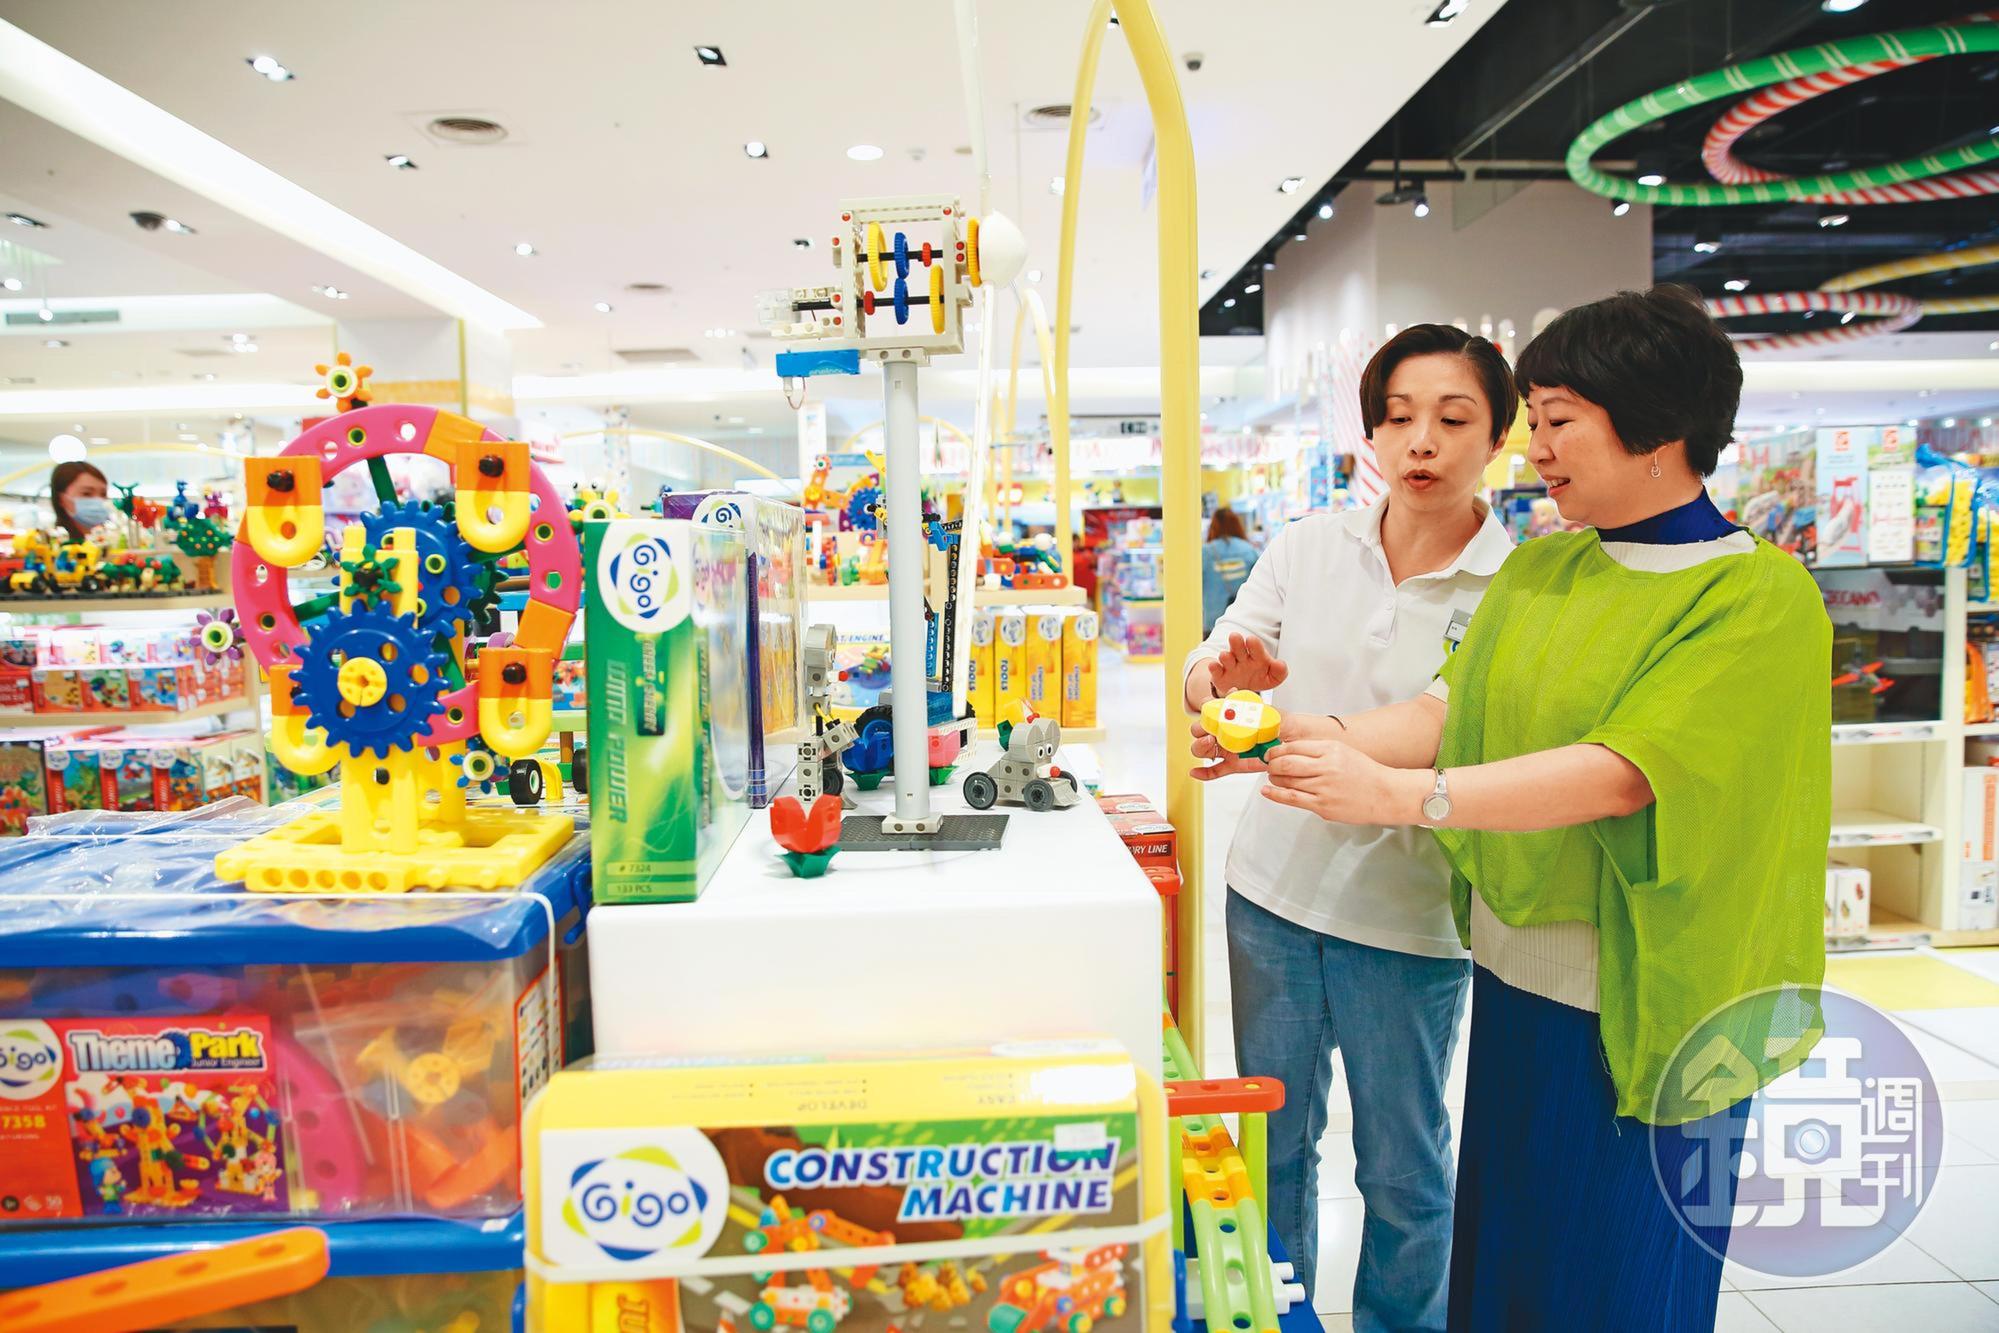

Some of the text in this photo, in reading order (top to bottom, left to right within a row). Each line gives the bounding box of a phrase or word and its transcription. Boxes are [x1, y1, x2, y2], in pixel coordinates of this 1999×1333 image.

[630, 544, 658, 608] Gigo
[1824, 588, 1882, 606] ECCANO
[608, 735, 628, 824] POWER
[1148, 844, 1168, 854] LINE
[635, 885, 652, 894] PCS
[69, 1030, 261, 1071] Theme Park
[769, 1138, 1116, 1185] CONSTRUCTION
[582, 1180, 690, 1228] Gigo
[903, 1180, 1109, 1217] MACHINE
